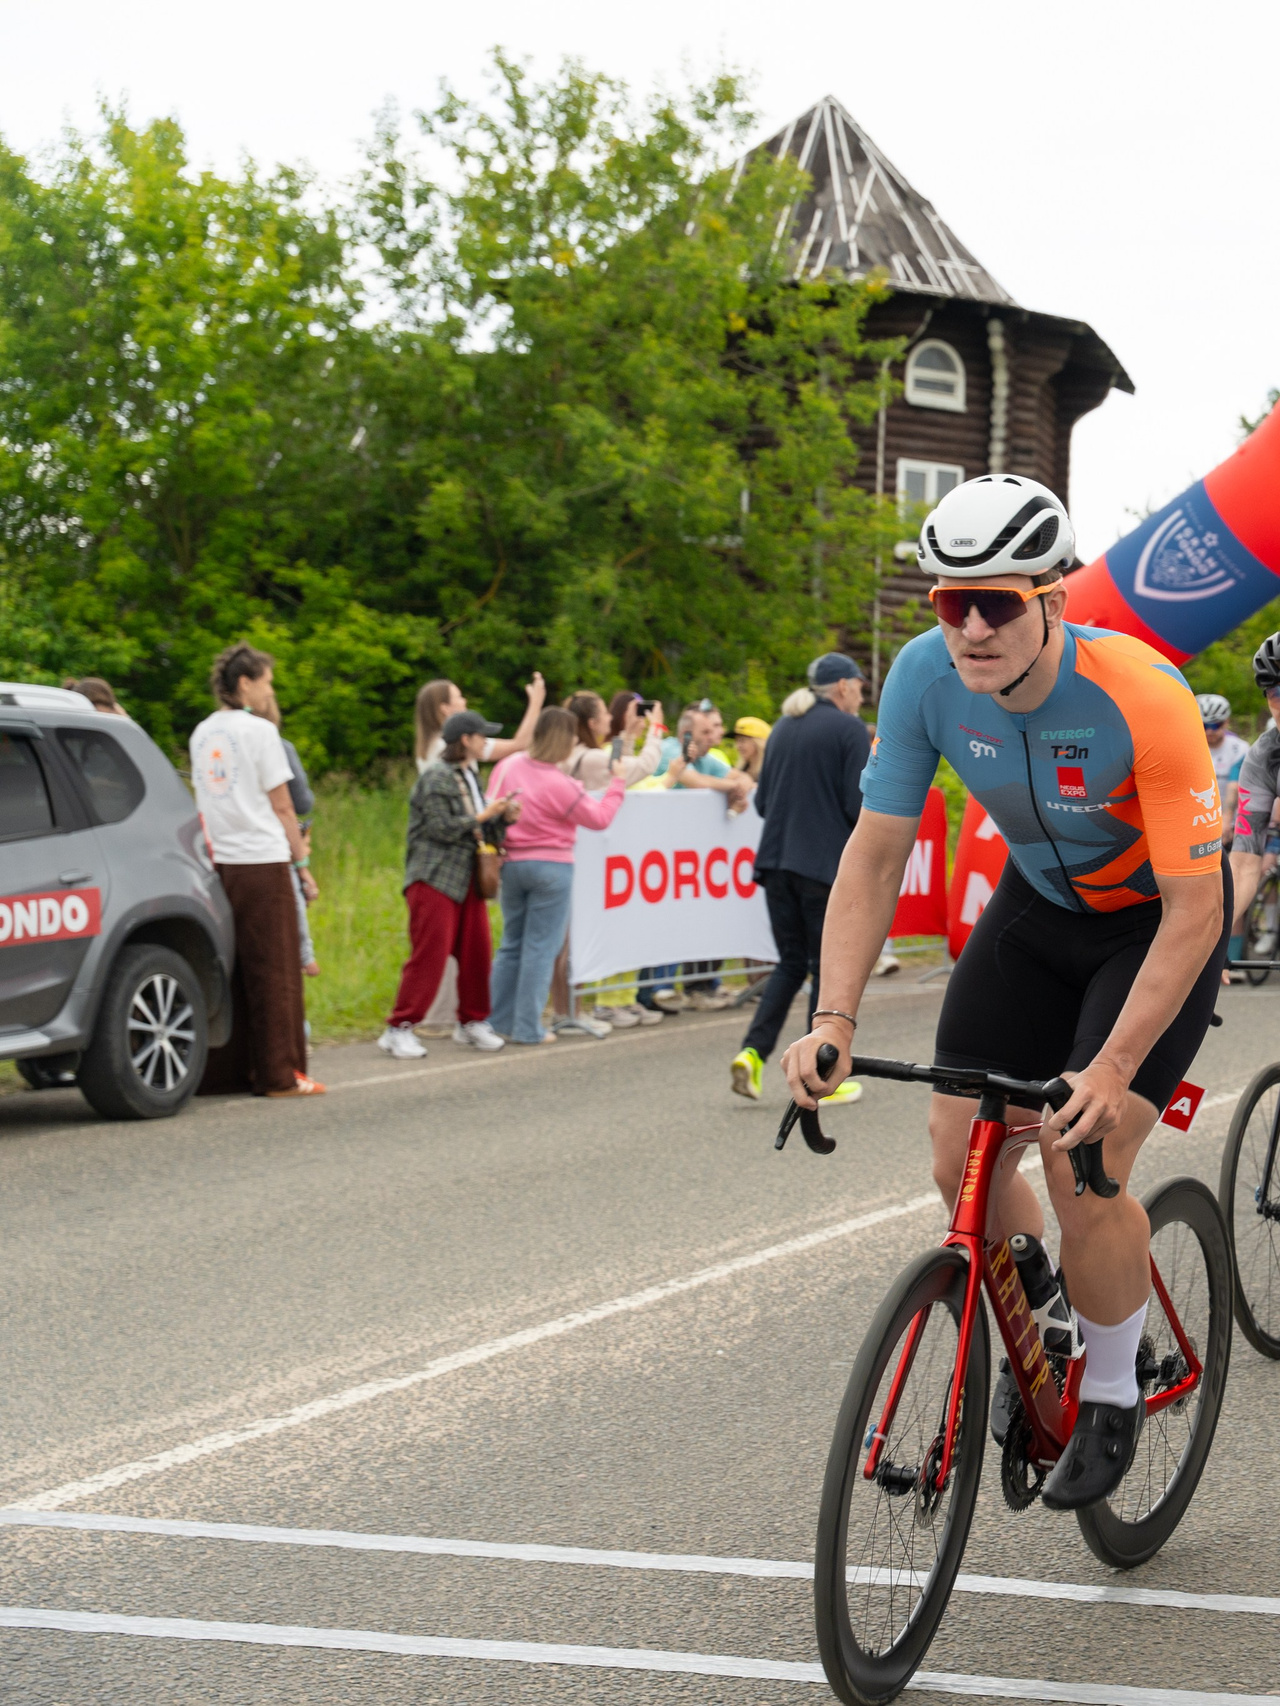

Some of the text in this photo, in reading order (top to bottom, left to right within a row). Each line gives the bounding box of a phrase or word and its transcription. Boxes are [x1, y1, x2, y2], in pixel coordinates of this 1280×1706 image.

[1174, 531, 1209, 575] FONDO
[1183, 527, 1218, 569] GRAN
[1040, 727, 1095, 740] EVERGO
[1046, 801, 1112, 813] UTECH
[604, 846, 758, 910] DORCO
[1169, 1096, 1192, 1116] A
[960, 1150, 982, 1203] RAPTOR
[990, 1239, 1050, 1399] RAPTOR
